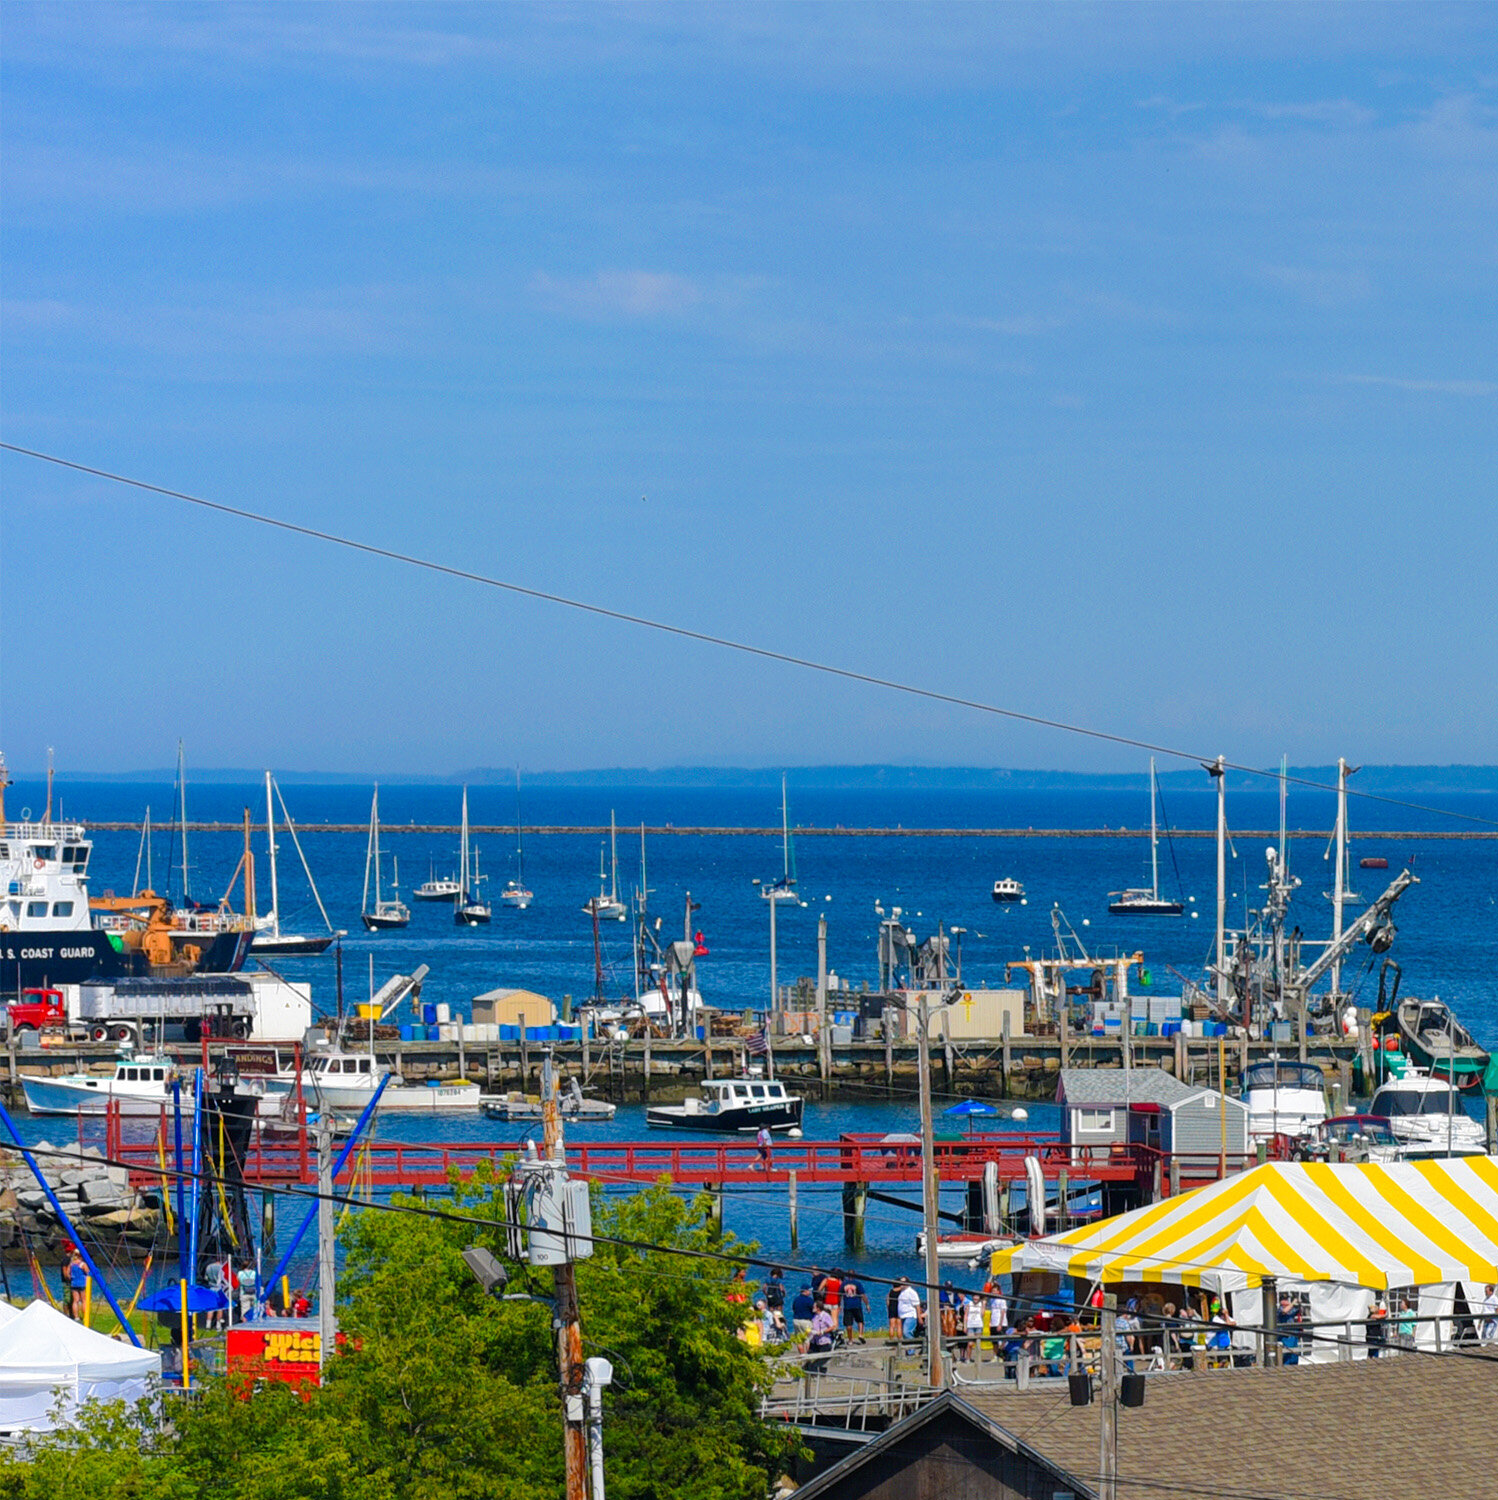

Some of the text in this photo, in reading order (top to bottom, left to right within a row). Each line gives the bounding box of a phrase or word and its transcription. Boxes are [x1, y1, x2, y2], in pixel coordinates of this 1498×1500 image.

[21, 948, 54, 959] COAST
[60, 947, 95, 958] GUARD
[235, 1054, 274, 1065] ANDINGS
[536, 1252, 549, 1262] 100
